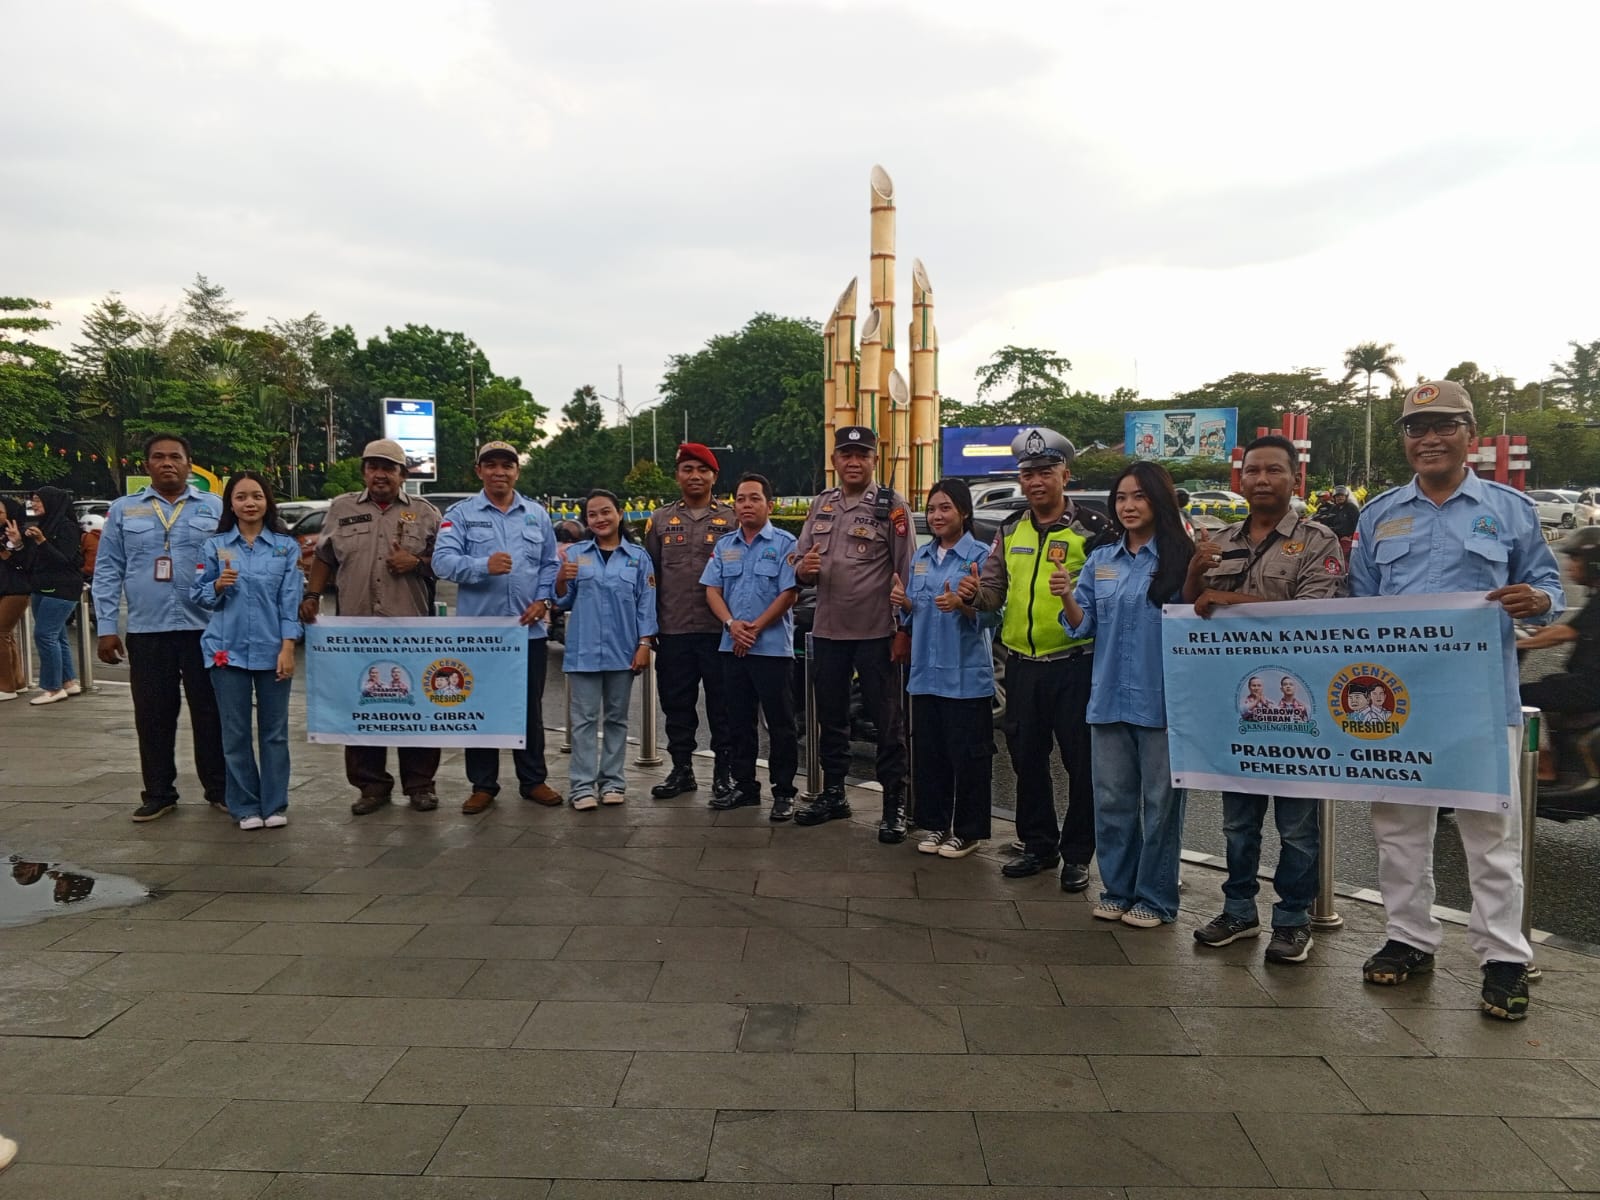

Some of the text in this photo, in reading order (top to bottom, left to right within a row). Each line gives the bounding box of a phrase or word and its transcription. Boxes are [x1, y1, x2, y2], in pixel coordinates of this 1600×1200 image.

[854, 516, 879, 528] POLRI
[326, 635, 503, 644] RELAWAN KANJENG PRABU
[1188, 626, 1454, 643] RELAWAN KANJENG PRABU
[312, 645, 351, 653] SELAMAT
[1172, 642, 1488, 656] SELAMAT BERBUKA PUASA RAMADHAN 1447 H
[1330, 673, 1350, 717] PRABU
[1351, 665, 1404, 694] CENTRE
[430, 694, 467, 703] PRESIDEN
[352, 712, 422, 720] PRABOWO
[433, 711, 485, 720] GIBRAN
[358, 723, 478, 731] PEMERSATU BANGSA
[1342, 720, 1400, 734] PRESIDEN
[1230, 743, 1331, 760] PRABOWO
[1350, 748, 1433, 764] GIBRAN
[1239, 761, 1422, 781] PEMERSATU BANGSA
